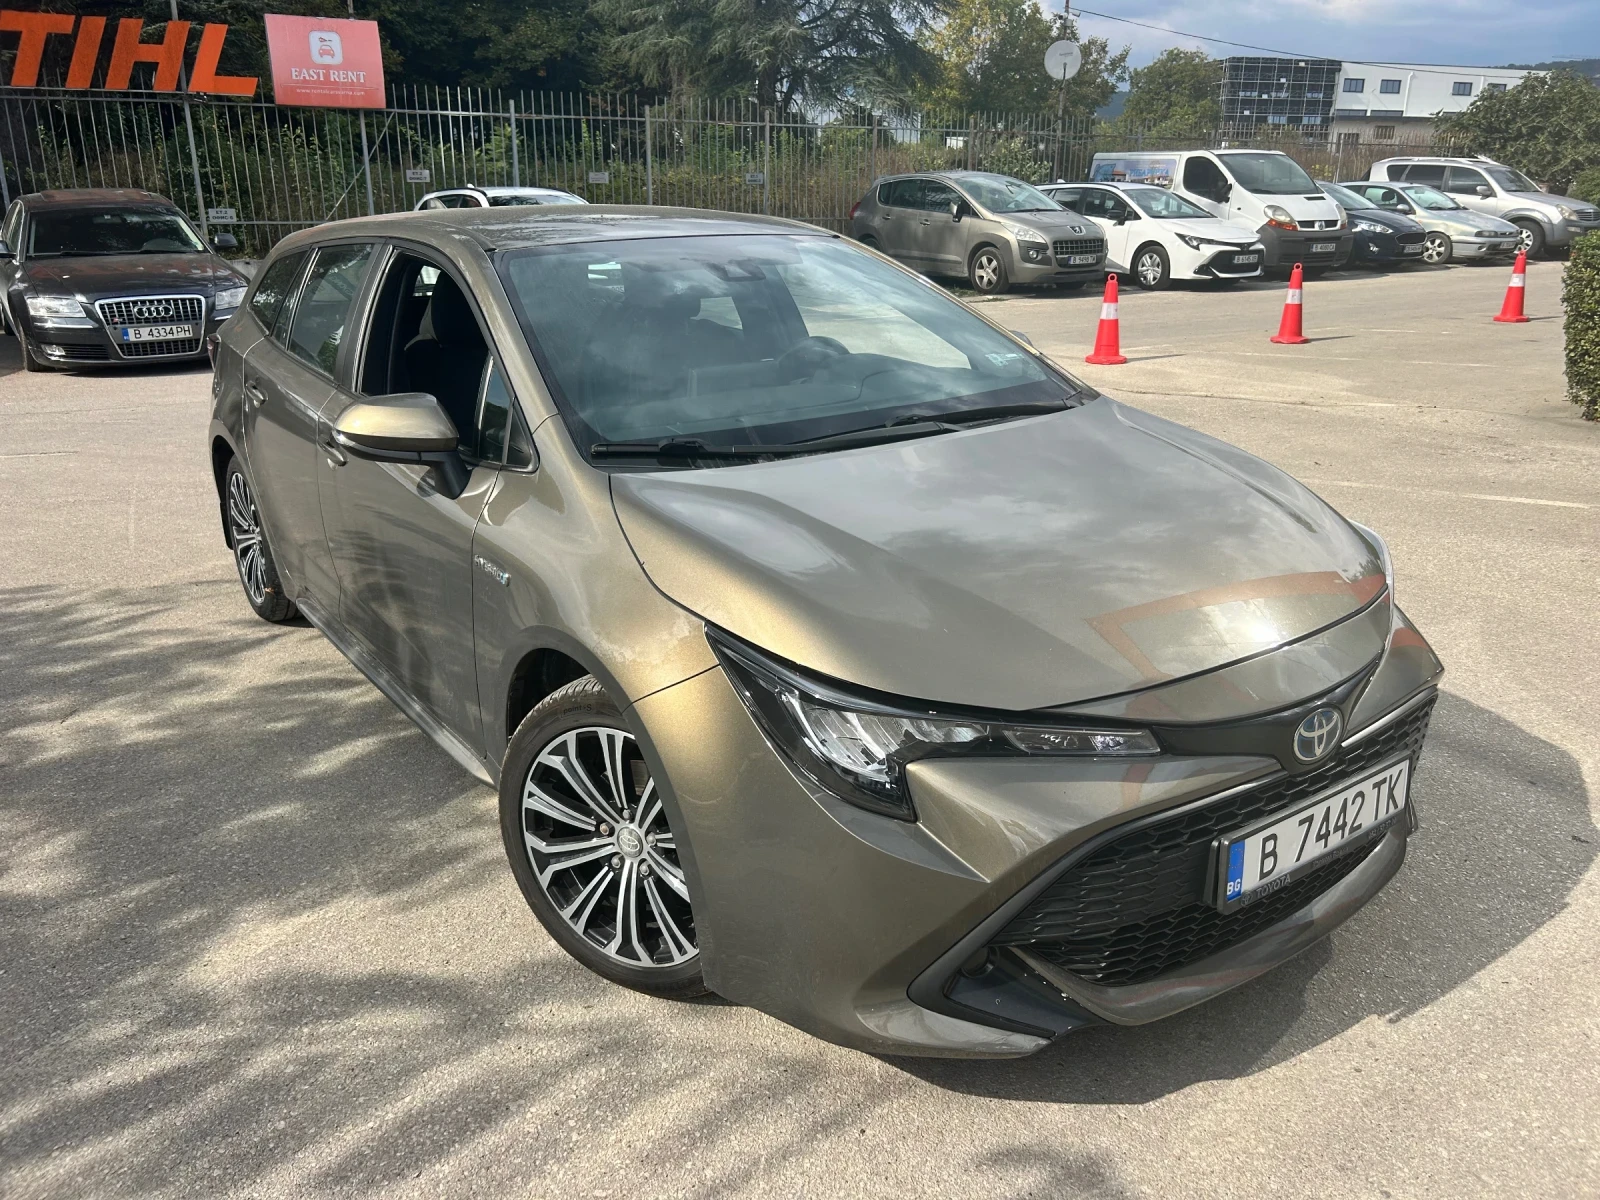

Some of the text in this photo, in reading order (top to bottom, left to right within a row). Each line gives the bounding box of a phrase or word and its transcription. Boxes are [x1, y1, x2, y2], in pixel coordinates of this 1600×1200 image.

[291, 67, 366, 83] EAST RENT
[133, 329, 142, 339] B
[1258, 833, 1278, 881] B
[1294, 790, 1366, 863] 7442
[1372, 768, 1403, 823] TK
[1226, 878, 1241, 896] BG
[1256, 873, 1291, 898] TOYOTA
